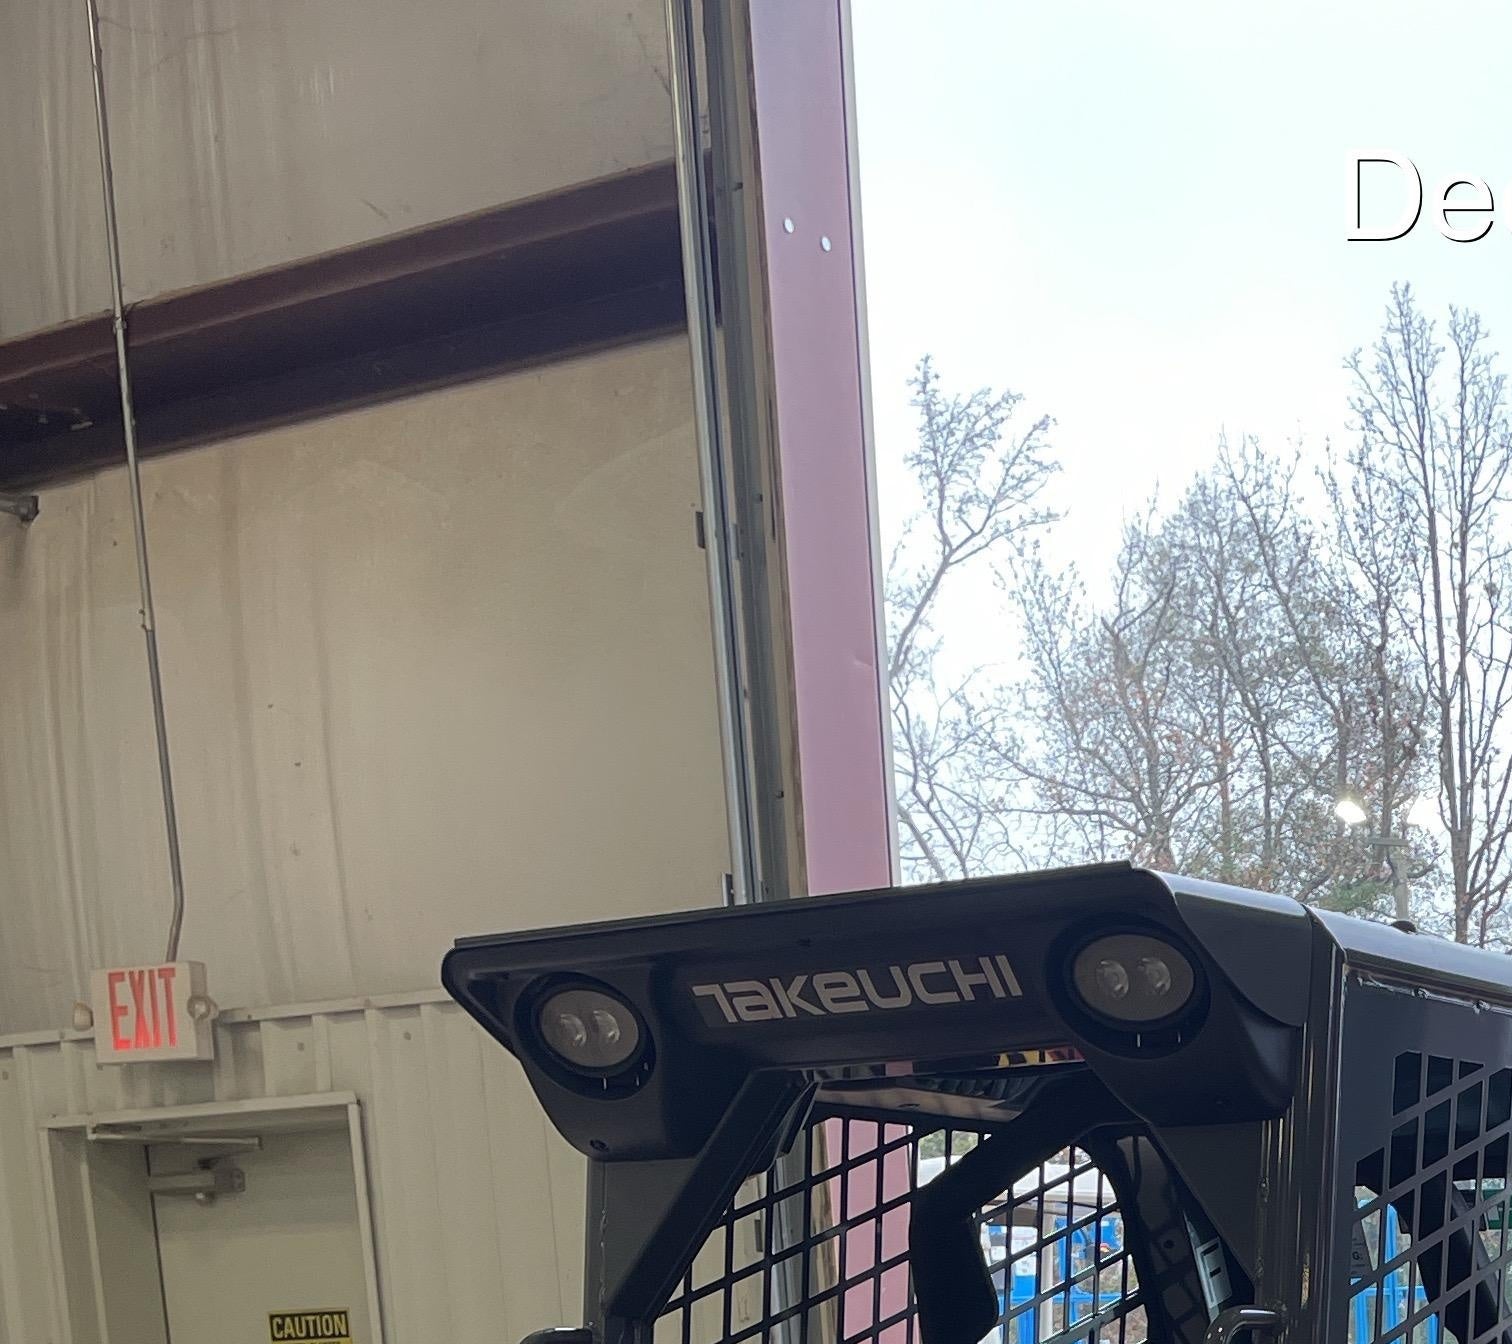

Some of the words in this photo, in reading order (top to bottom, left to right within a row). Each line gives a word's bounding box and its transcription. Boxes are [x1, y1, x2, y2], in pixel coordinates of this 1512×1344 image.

[107, 967, 177, 1050] EXIT
[692, 955, 1023, 1023] TAKEUCHI
[272, 1314, 347, 1338] CAUTION
